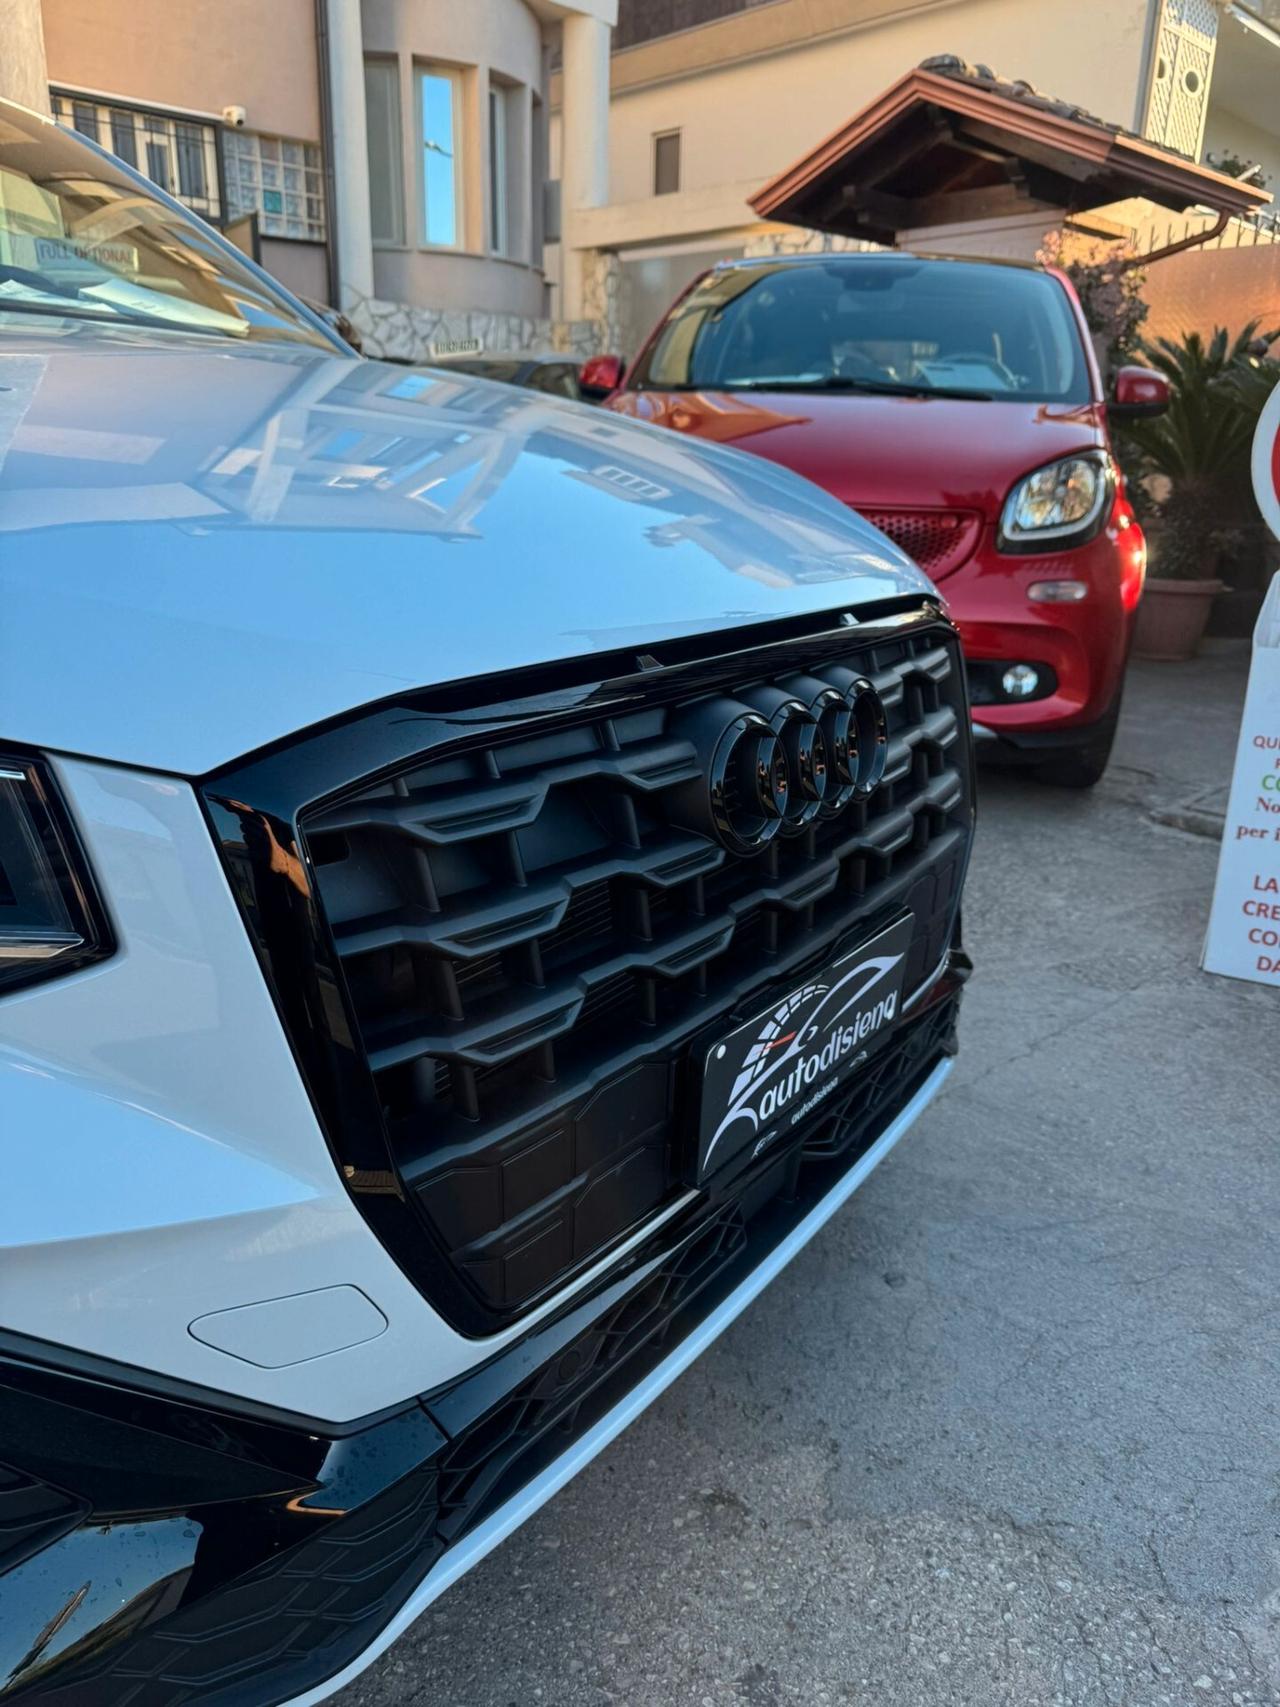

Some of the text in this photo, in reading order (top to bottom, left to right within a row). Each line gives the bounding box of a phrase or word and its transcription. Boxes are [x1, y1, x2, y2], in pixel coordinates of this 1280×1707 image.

[39, 242, 132, 264] FULL OPTIONAL
[1252, 734, 1280, 750] QU
[1236, 825, 1269, 839] per
[1253, 875, 1278, 894] LA
